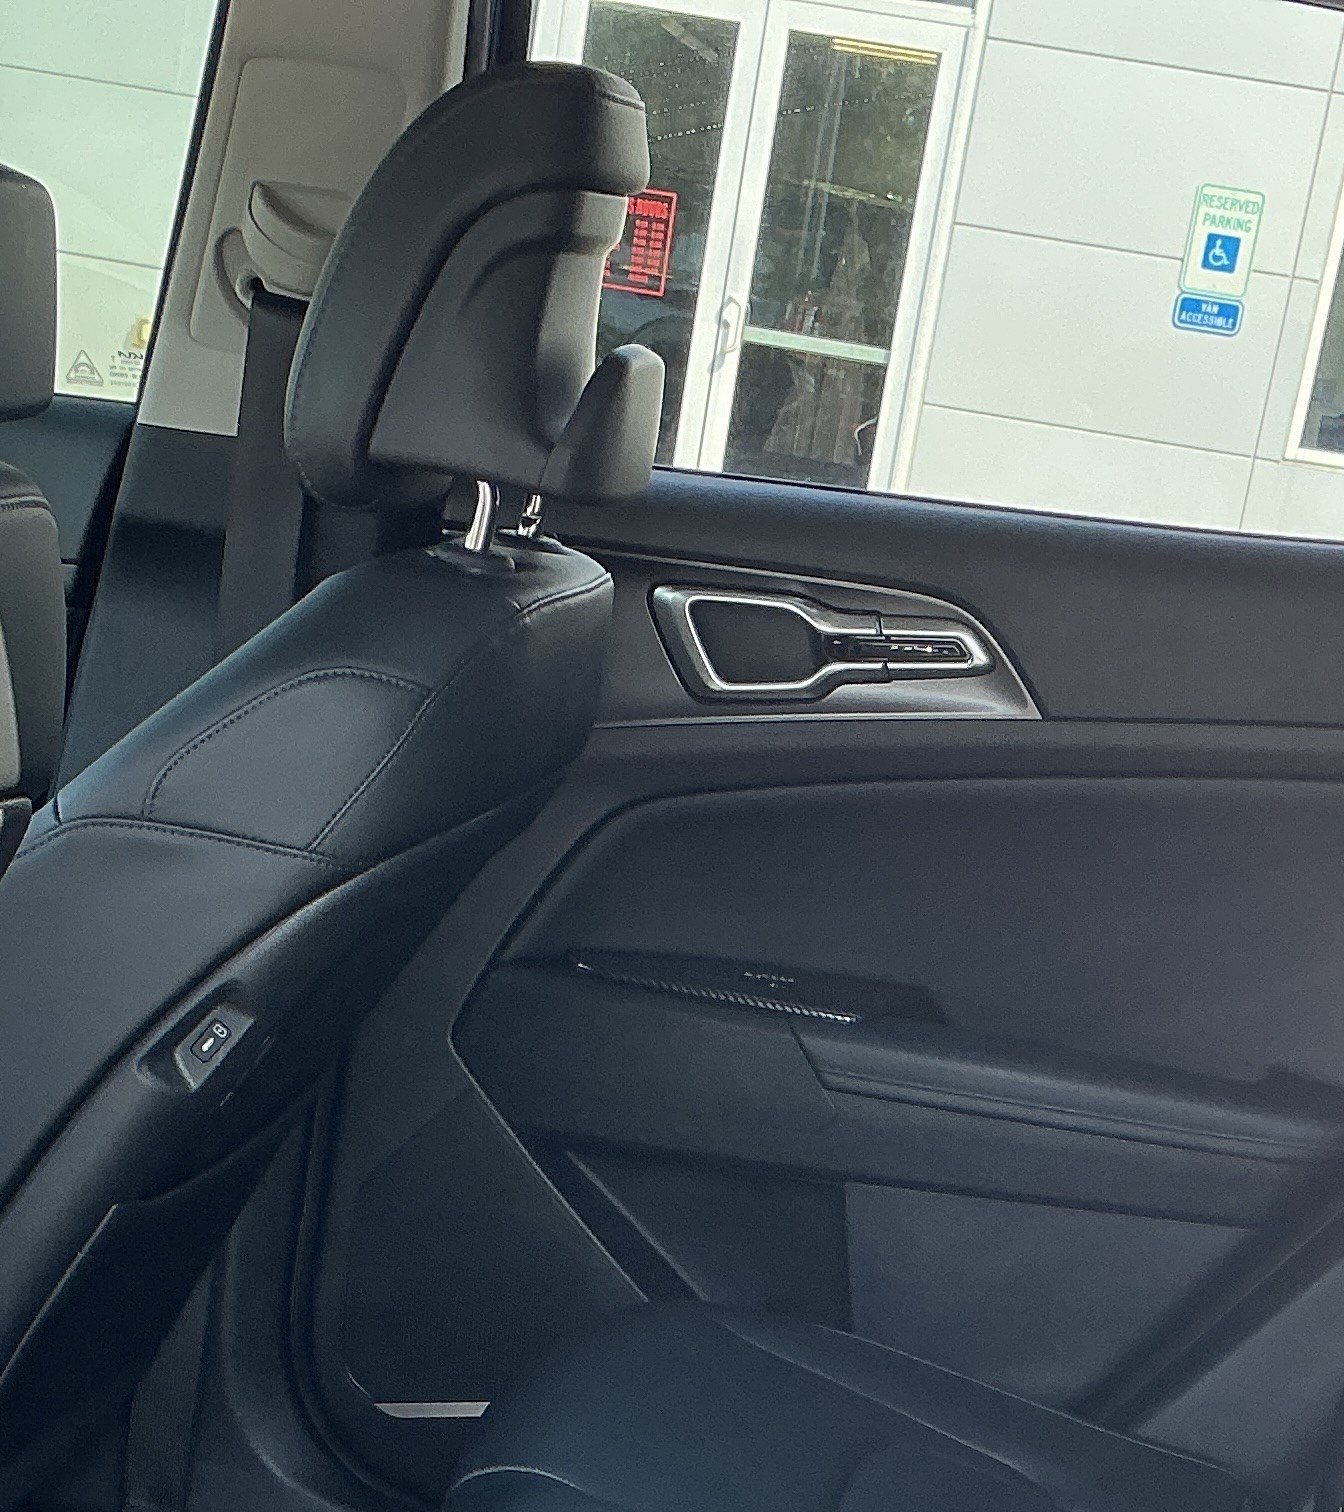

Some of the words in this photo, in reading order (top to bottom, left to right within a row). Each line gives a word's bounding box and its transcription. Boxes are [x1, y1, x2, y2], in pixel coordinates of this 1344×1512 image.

[1200, 193, 1260, 215] RESERVED
[1202, 212, 1253, 233] PARKING
[1201, 301, 1219, 315] VAN
[1180, 310, 1234, 329] ACCESSIBLE
